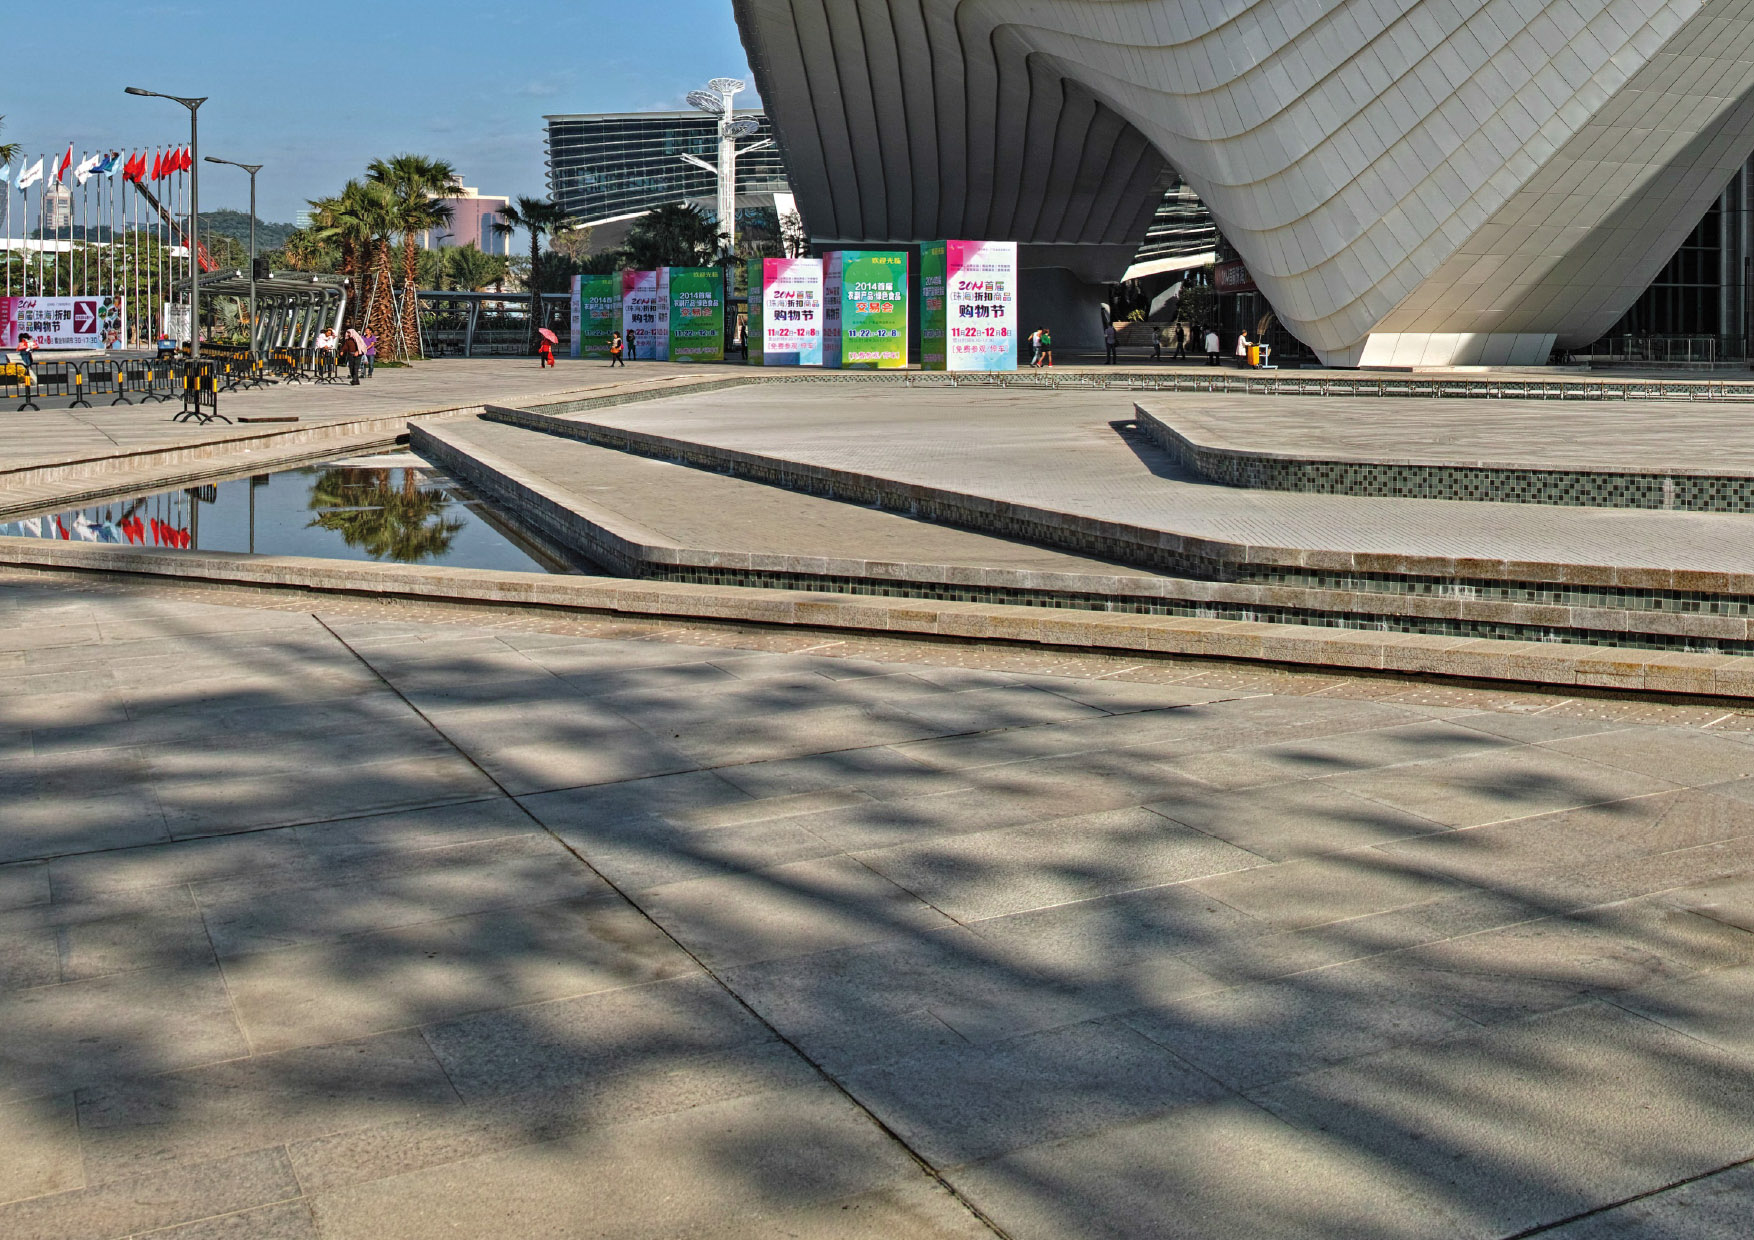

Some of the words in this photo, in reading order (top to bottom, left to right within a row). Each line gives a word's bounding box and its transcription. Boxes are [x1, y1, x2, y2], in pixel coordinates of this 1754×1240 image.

[855, 282, 893, 291] 2014首届
[855, 302, 894, 313] 交易会
[958, 304, 1006, 318] 购物节
[773, 310, 814, 321] 购物节
